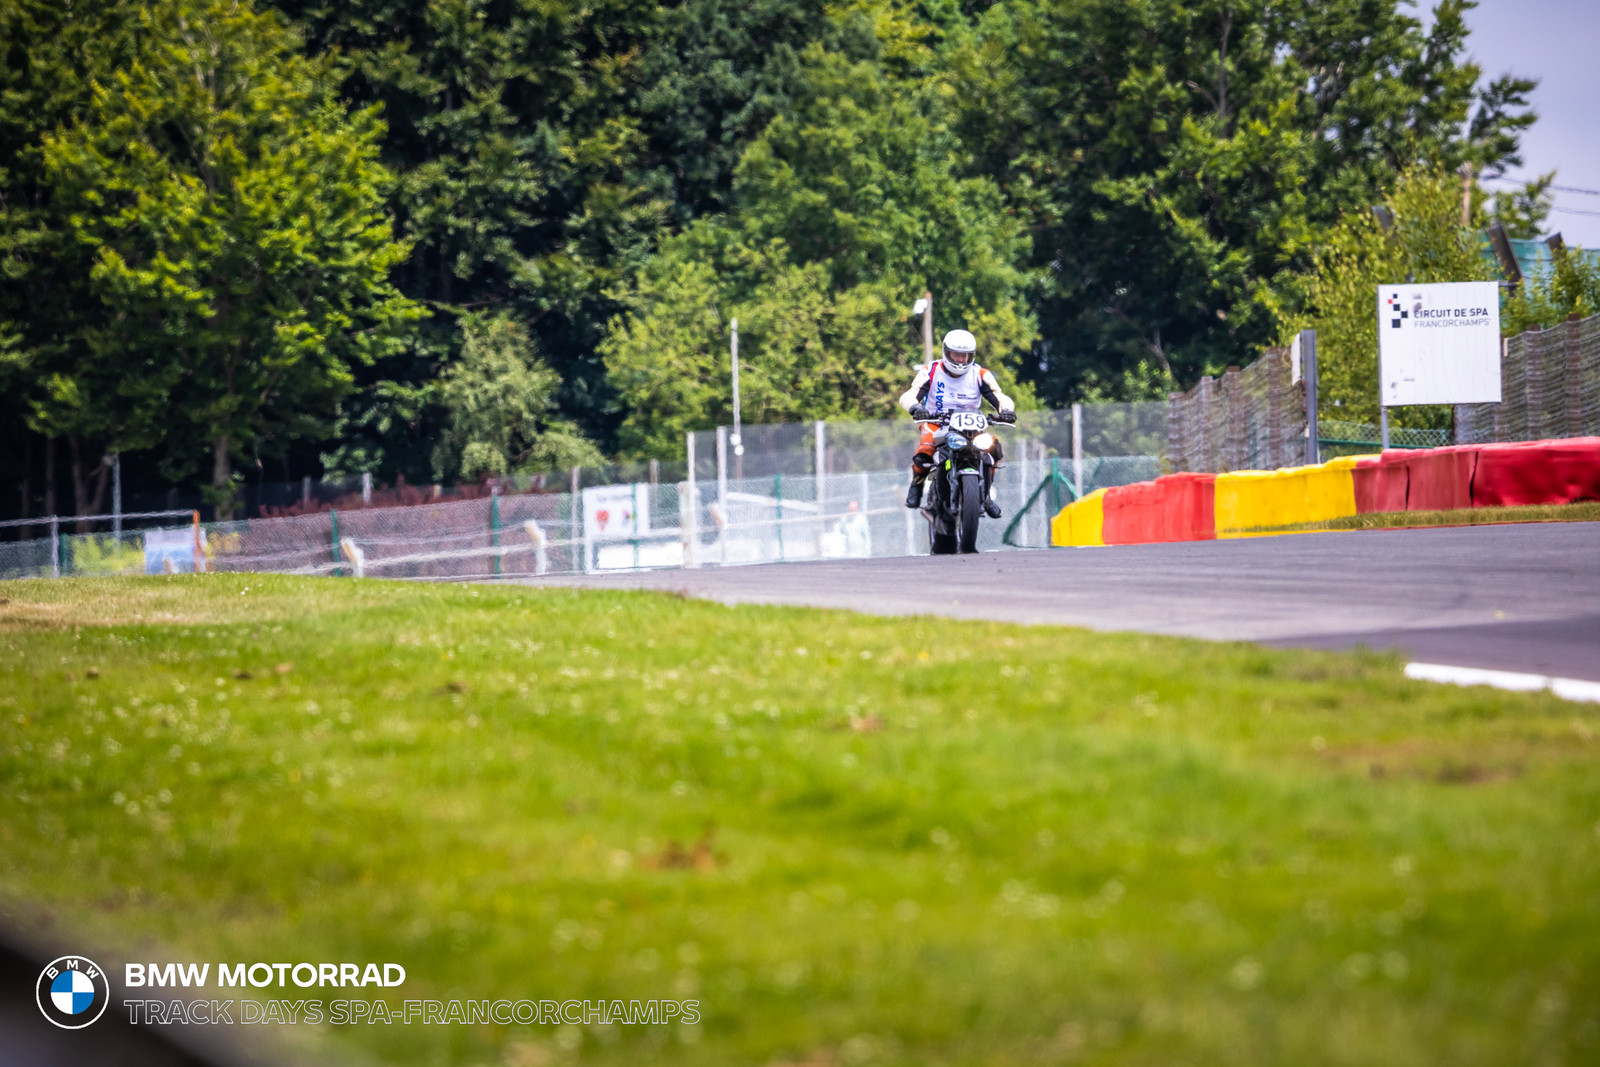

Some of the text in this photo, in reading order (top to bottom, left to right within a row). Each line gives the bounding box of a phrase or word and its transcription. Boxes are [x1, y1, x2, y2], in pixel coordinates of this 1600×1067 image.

[1414, 307, 1488, 318] CIRCUIT DE SPA
[1414, 319, 1490, 328] FRANCORCHAMPS
[954, 413, 986, 429] 159
